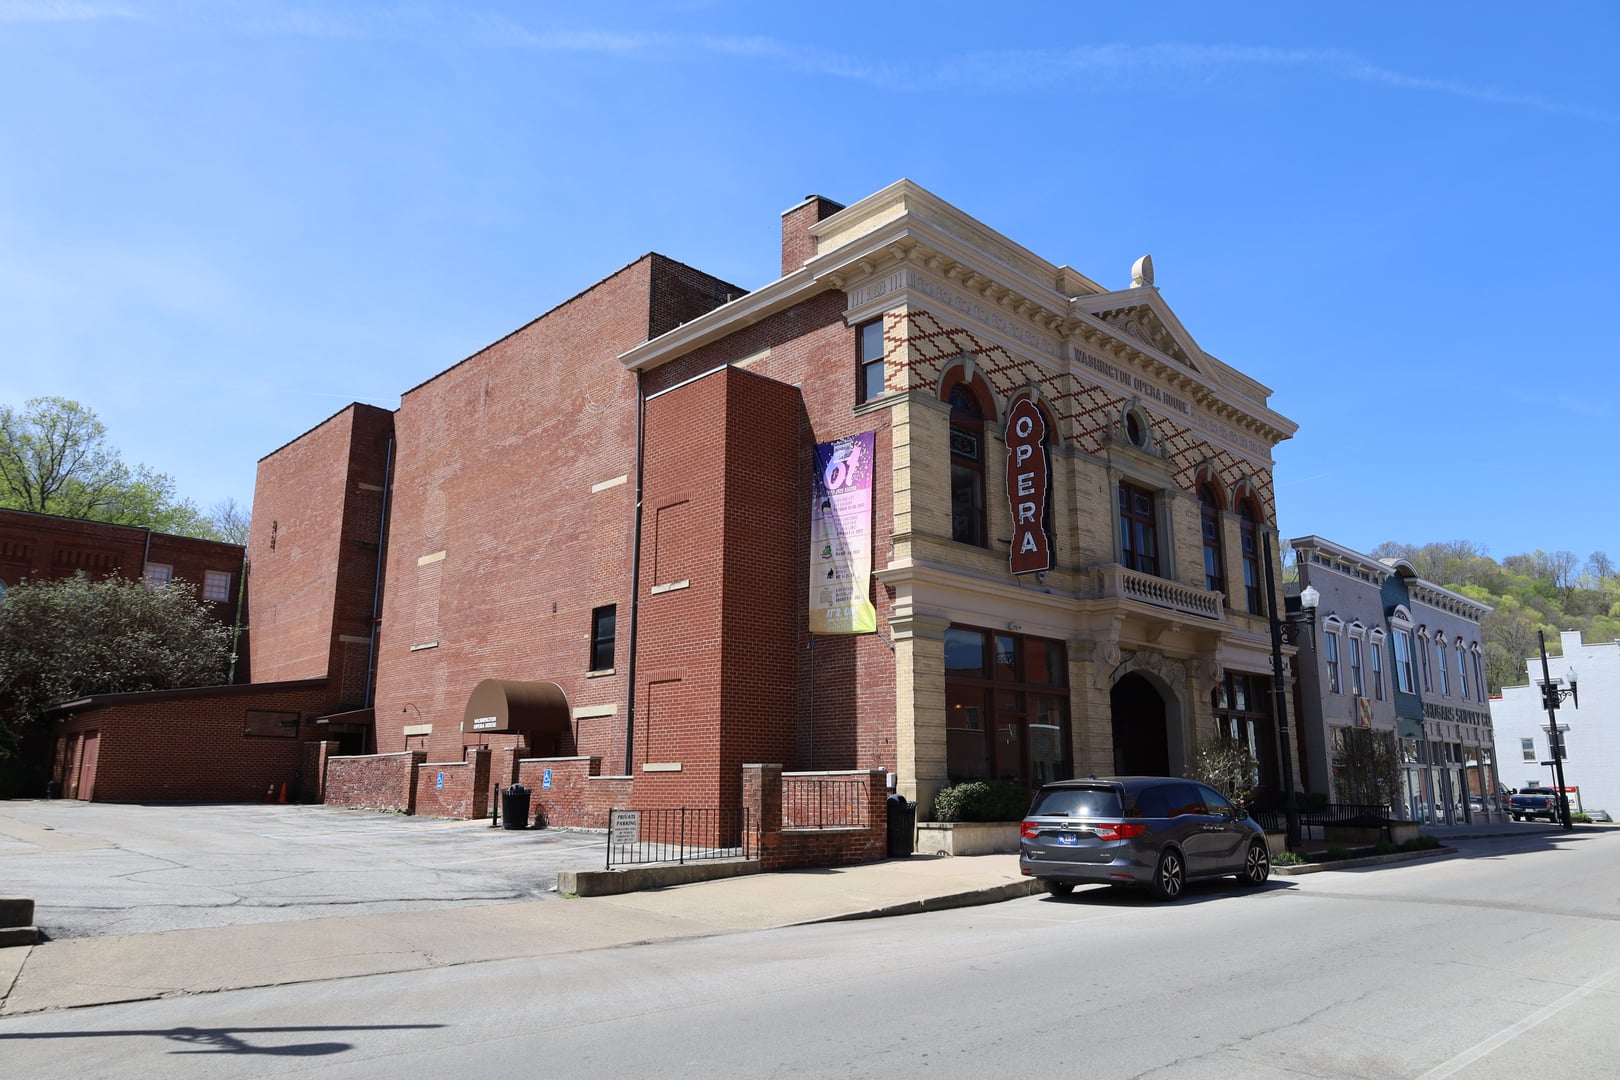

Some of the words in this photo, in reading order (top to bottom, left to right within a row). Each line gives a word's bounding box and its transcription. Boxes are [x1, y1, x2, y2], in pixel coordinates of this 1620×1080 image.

[1073, 347, 1132, 386] WASHINGTON
[1133, 377, 1161, 402] OPERA
[1162, 391, 1189, 415] HOUSE
[1015, 416, 1038, 554] OPERA
